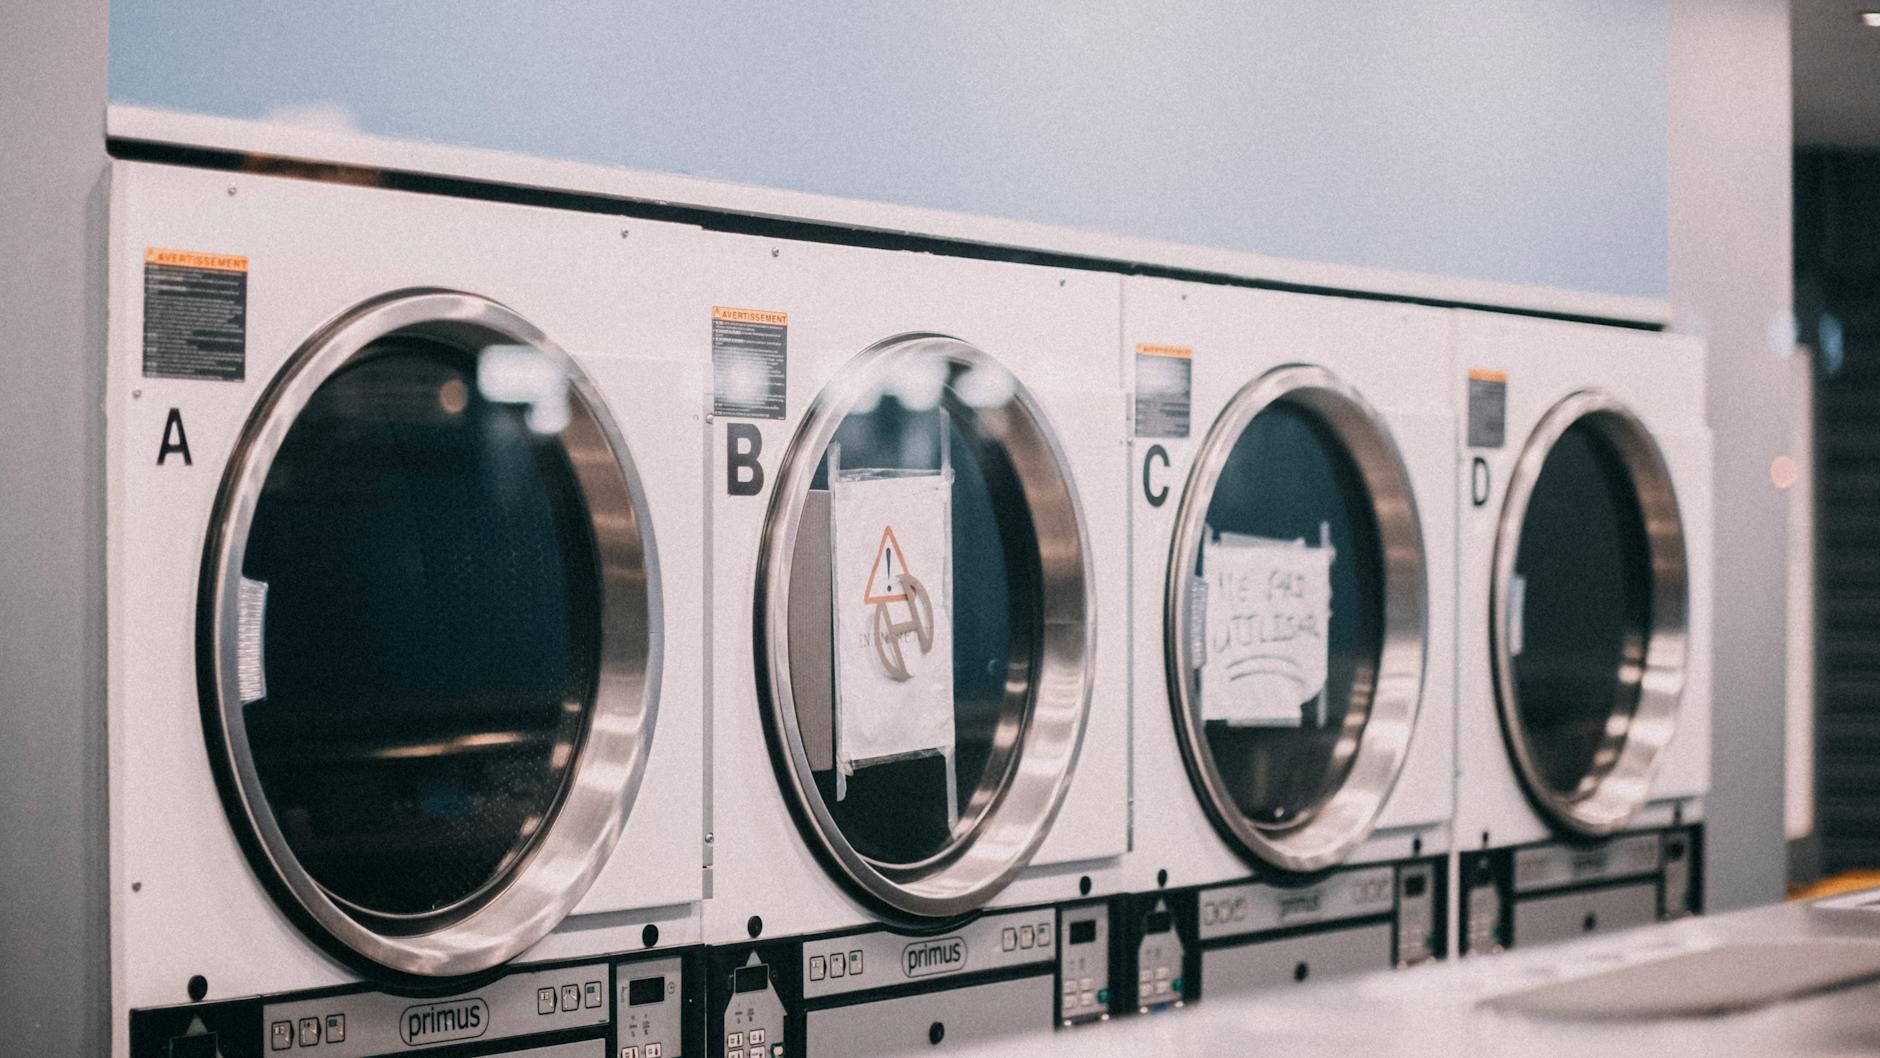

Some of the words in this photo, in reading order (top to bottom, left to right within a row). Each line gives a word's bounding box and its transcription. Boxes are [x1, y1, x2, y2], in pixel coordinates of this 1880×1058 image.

[157, 251, 248, 269] AVERTISSEMENT
[721, 310, 788, 324] AVERTISSEMENT
[156, 407, 193, 466] A
[727, 423, 764, 496] B
[1143, 444, 1170, 508] C
[1472, 456, 1489, 507] D
[908, 942, 961, 975] primus
[408, 1004, 481, 1043] primus
